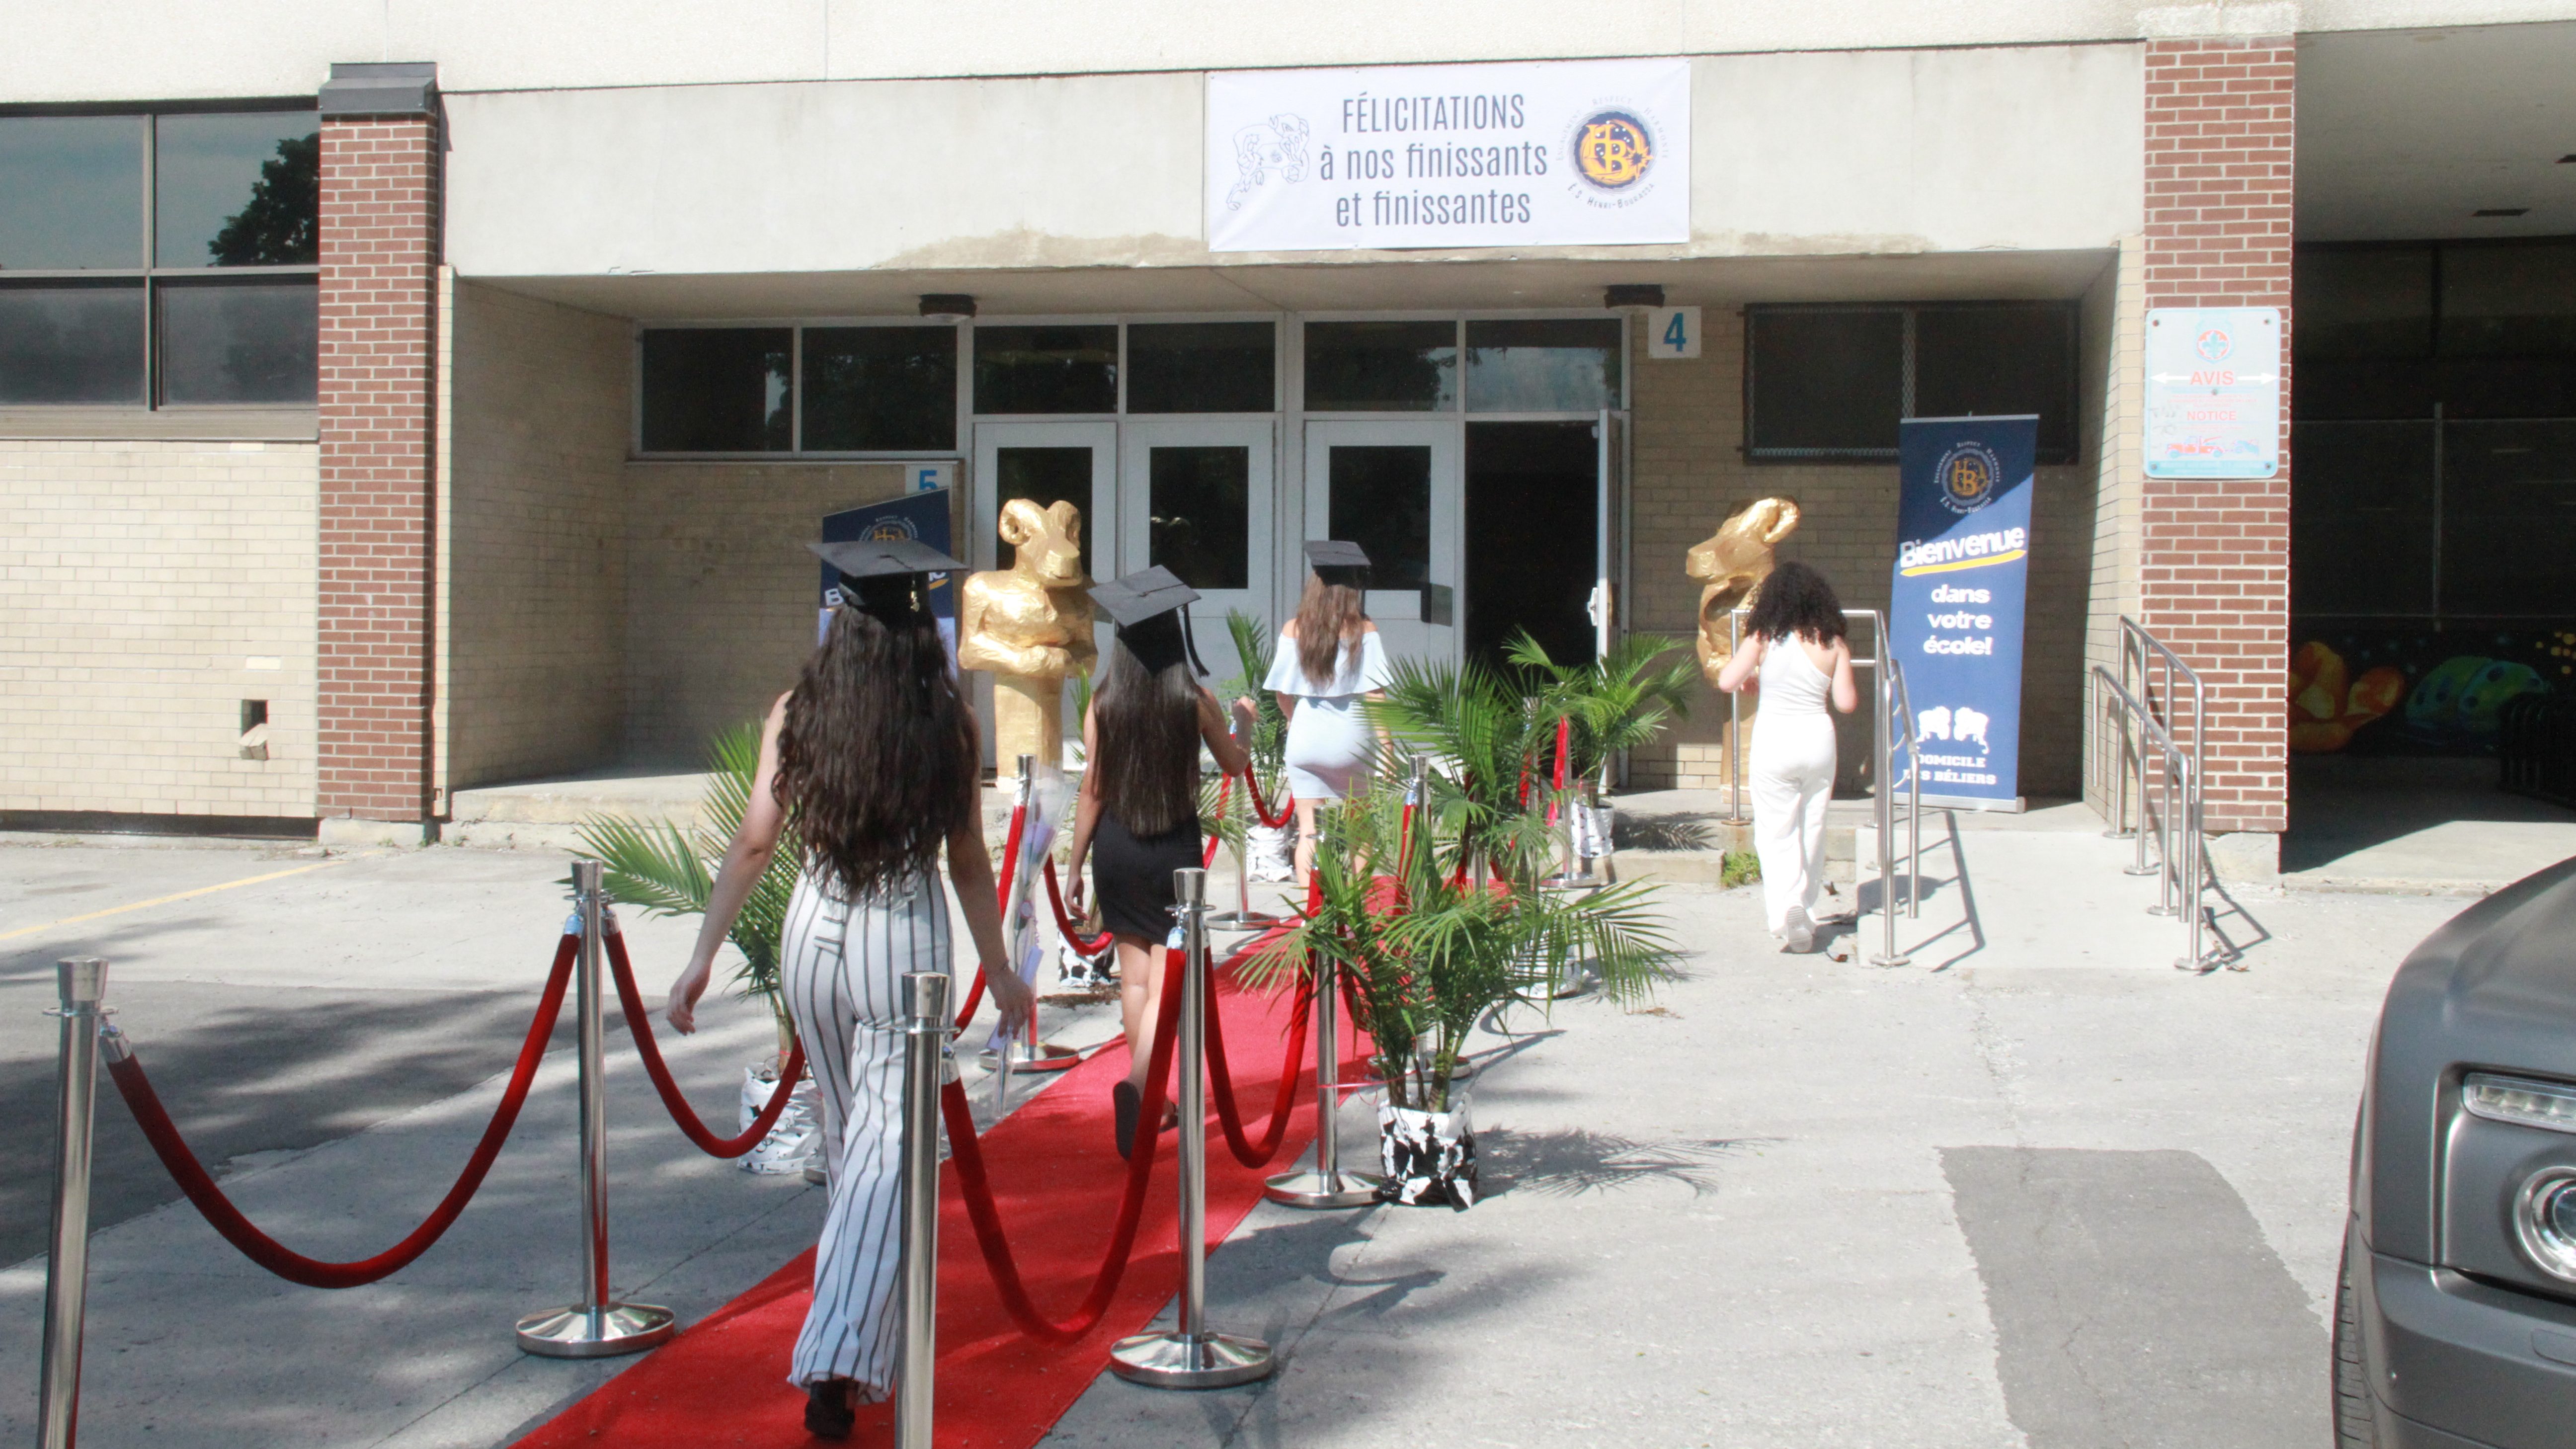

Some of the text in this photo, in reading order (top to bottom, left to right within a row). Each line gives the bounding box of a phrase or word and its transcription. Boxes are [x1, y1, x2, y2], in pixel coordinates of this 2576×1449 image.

[1343, 91, 1525, 133] FÉLICITATIONS
[1320, 141, 1548, 180] à nos finissants
[1336, 189, 1531, 227] et finissantes
[1663, 312, 1687, 352] 4
[2189, 371, 2235, 386] AVIS
[2187, 410, 2237, 420] NOTICE
[1900, 527, 2025, 567] Bienvenue
[1931, 584, 1992, 604] dans
[1927, 611, 1992, 630] votre
[1923, 635, 1994, 655] école!
[1933, 769, 1997, 785] BÉLIERS
